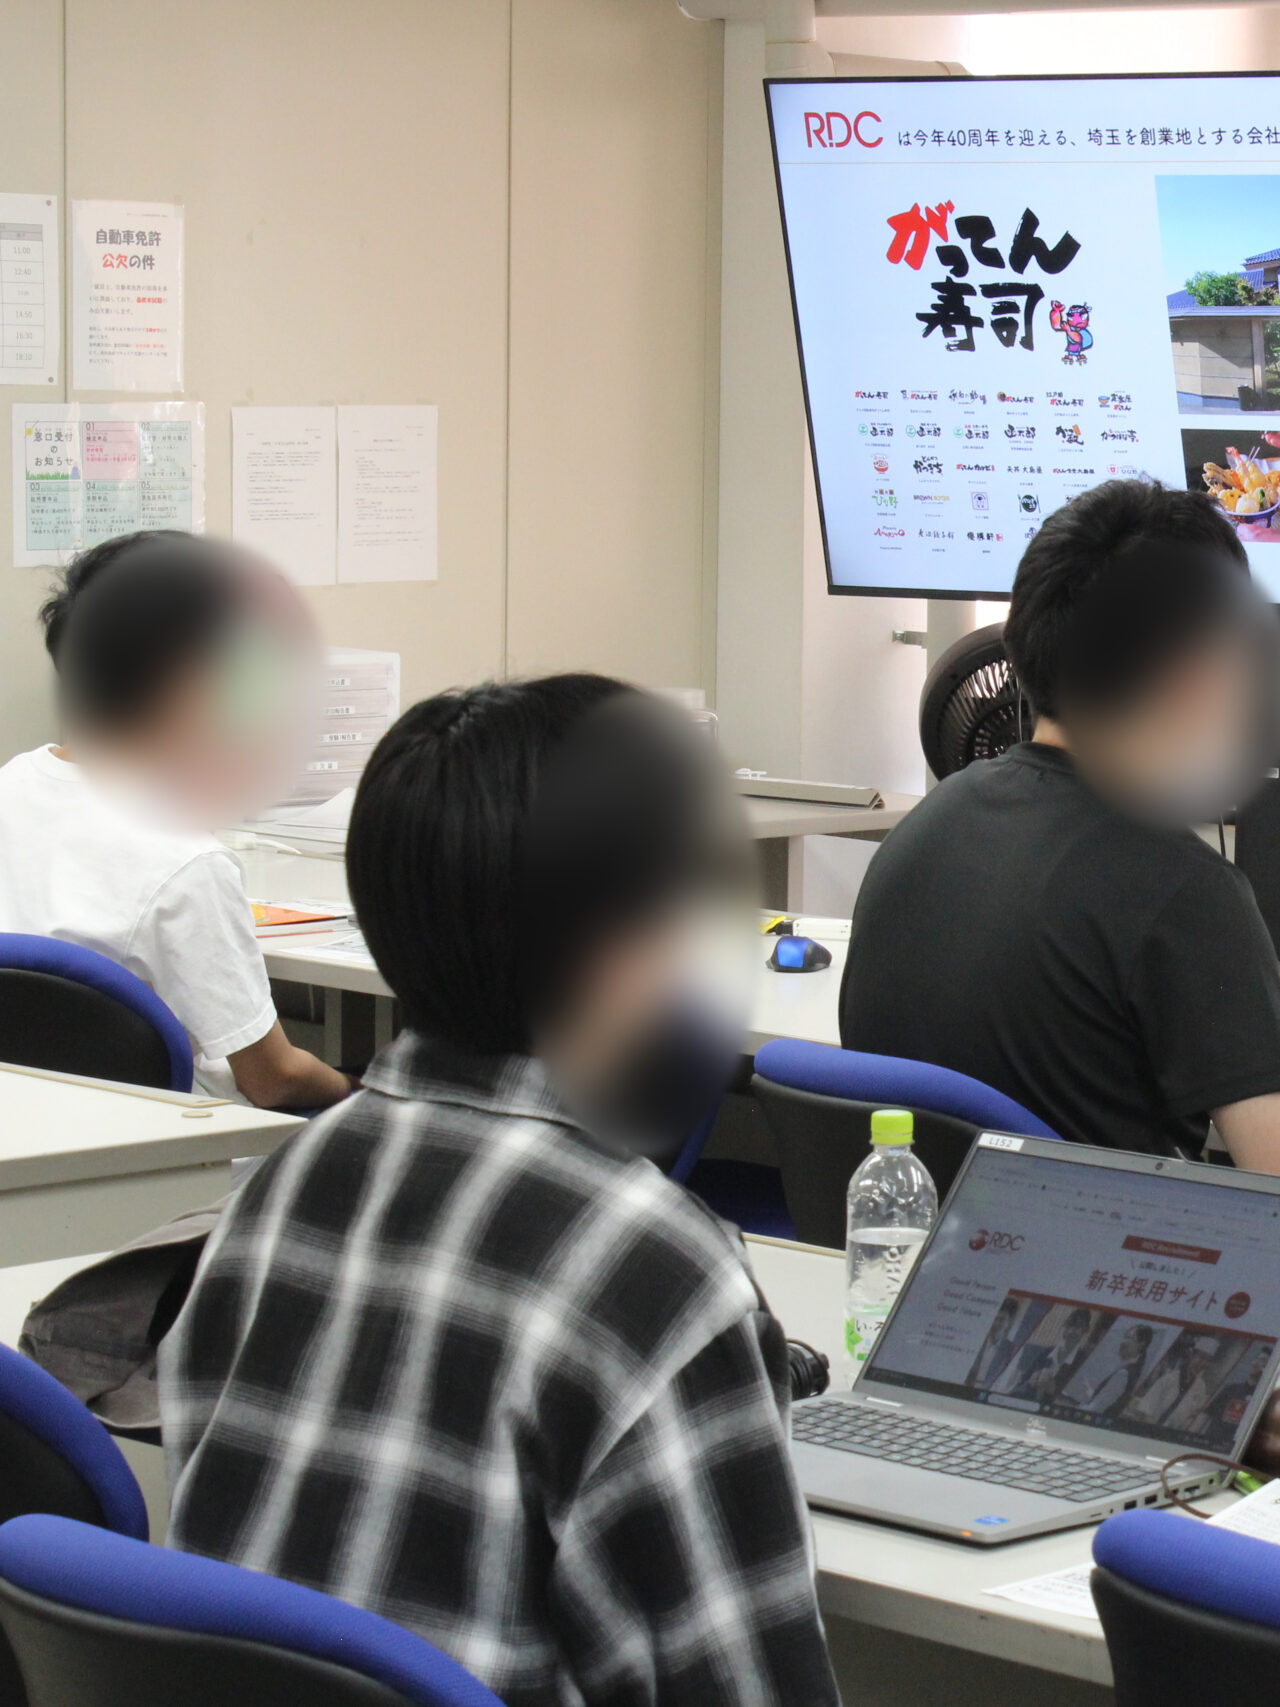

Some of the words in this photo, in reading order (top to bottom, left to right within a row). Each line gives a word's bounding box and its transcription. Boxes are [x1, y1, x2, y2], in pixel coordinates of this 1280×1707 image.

[804, 110, 883, 148] RDC
[95, 228, 162, 247] 自動車免許
[886, 200, 1081, 277] がってん
[101, 252, 156, 270] 公欠の件
[915, 276, 1045, 352] 寿司
[988, 1135, 1013, 1148] L152
[989, 1231, 1025, 1251] RDC
[1085, 1268, 1218, 1312] 新卒採用サイト
